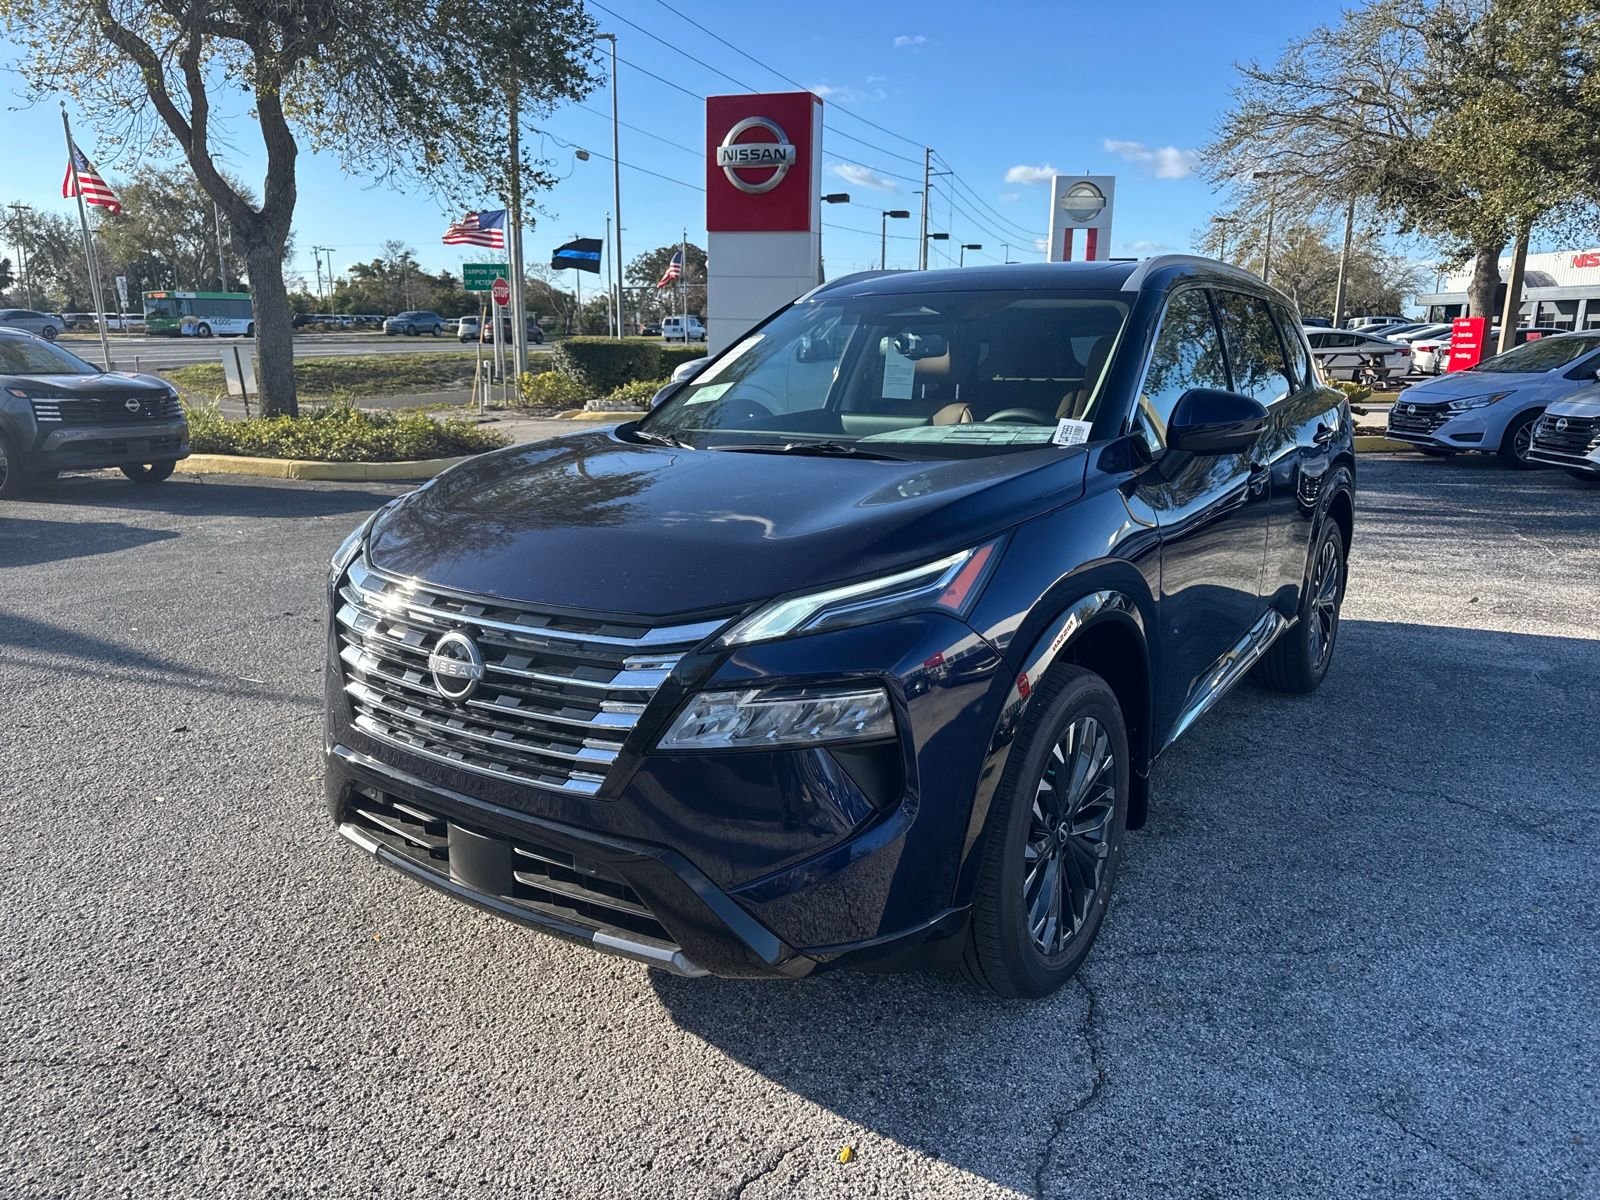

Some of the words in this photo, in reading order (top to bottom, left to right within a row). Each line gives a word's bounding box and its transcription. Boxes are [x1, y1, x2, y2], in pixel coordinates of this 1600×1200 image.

[723, 148, 787, 162] NISSAN
[493, 286, 509, 297] STOP
[1454, 352, 1472, 360] Parking
[428, 655, 482, 678] NISSAN
